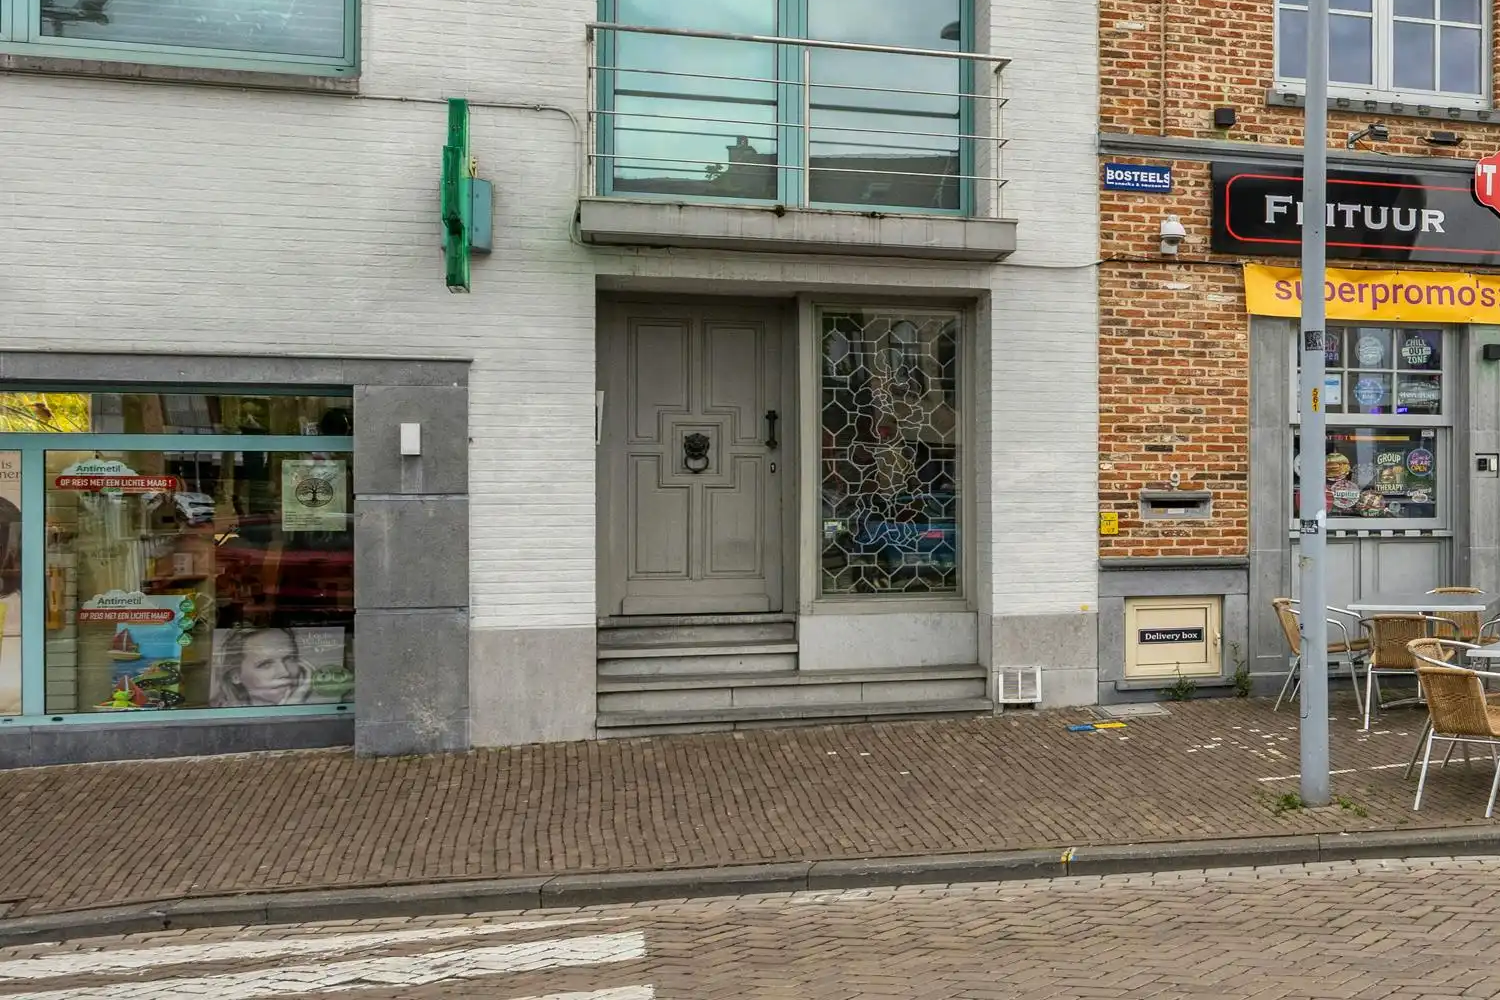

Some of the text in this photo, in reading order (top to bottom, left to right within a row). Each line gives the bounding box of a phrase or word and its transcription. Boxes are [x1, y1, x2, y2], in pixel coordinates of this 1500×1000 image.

[1107, 169, 1169, 183] BOSTEELS
[1405, 338, 1427, 347] CHILL
[1408, 347, 1424, 355] OUT
[1407, 355, 1428, 364] ZONE
[1377, 453, 1401, 465] GROUP
[76, 465, 121, 473] Antimetil
[71, 479, 88, 487] REIS
[90, 479, 105, 487] MET
[106, 479, 120, 487] EEN
[121, 479, 146, 487] LICHTE
[1170, 471, 1181, 487] 9
[97, 597, 142, 605] Antimetil
[1145, 632, 1198, 642] Delivery box
